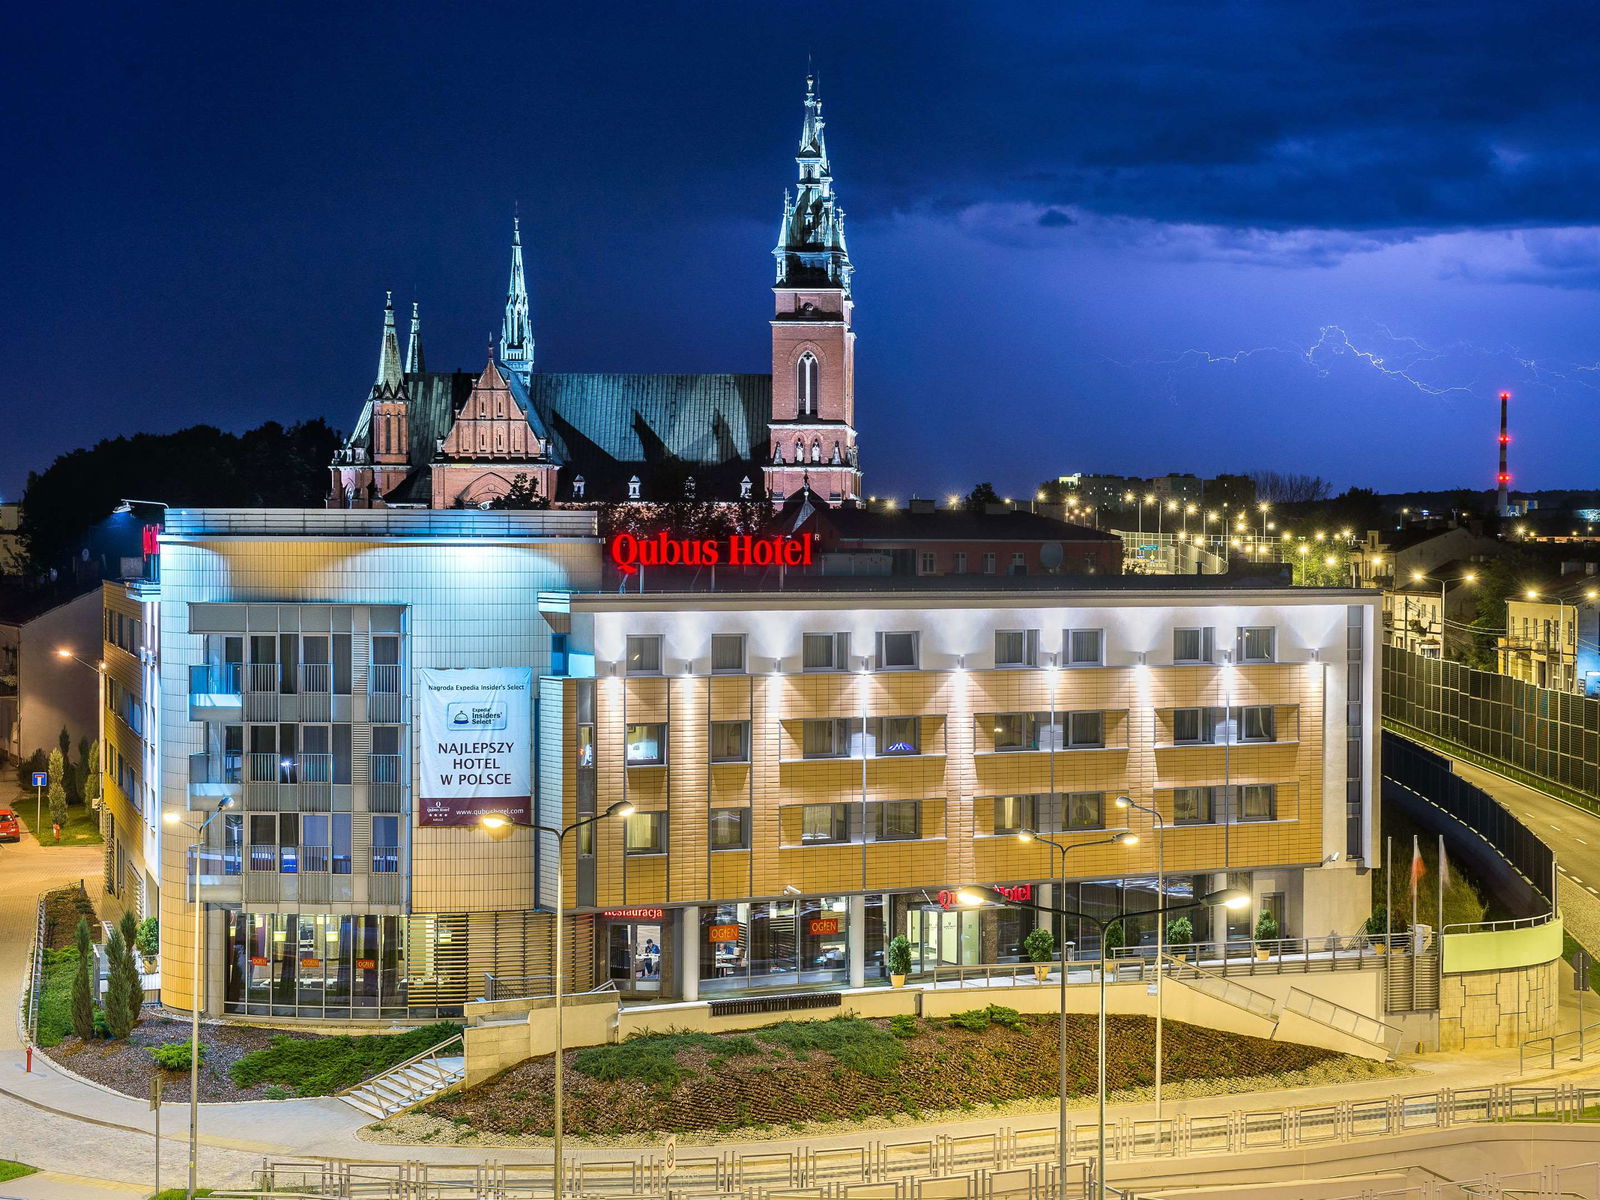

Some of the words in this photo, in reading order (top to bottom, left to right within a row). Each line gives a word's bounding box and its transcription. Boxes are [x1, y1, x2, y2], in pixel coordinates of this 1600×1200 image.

[611, 531, 719, 574] Qubus
[729, 532, 813, 566] Hotel
[438, 742, 514, 754] NAJLEPSZY
[453, 758, 500, 770] HOTEL
[440, 774, 453, 785] W
[459, 773, 512, 785] POLSCE
